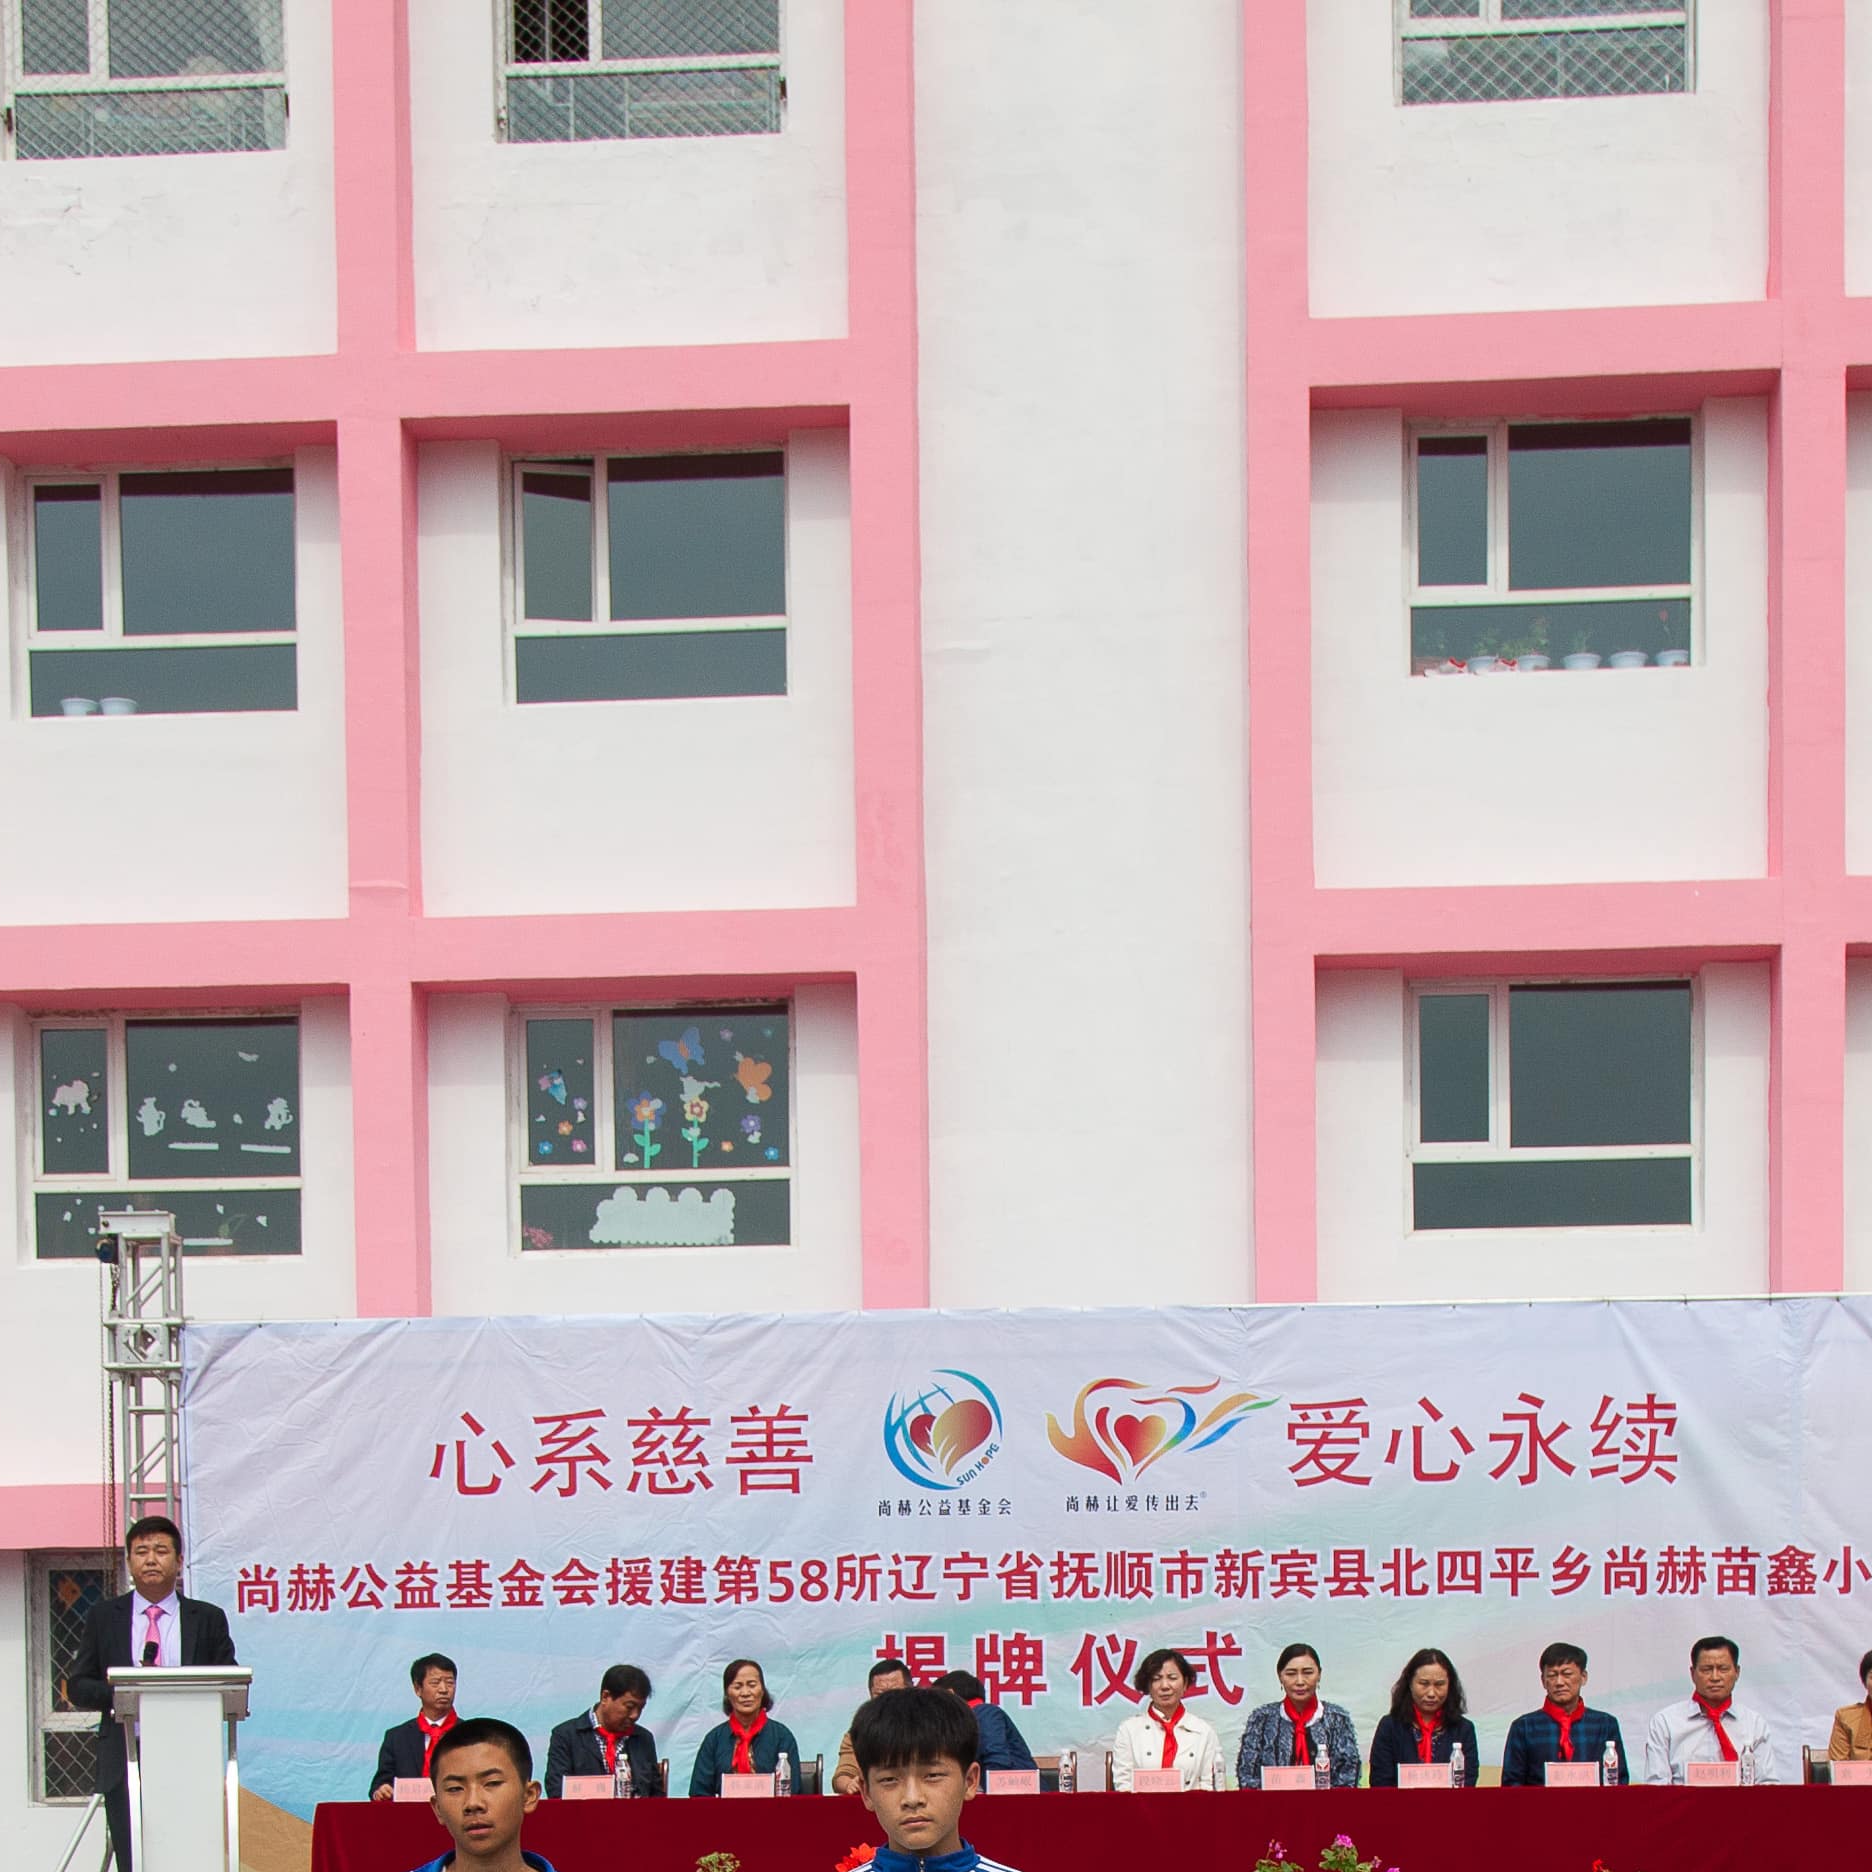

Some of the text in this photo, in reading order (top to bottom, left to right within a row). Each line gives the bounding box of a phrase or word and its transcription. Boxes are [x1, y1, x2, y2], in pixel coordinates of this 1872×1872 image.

[430, 1404, 814, 1497] 心系慈善
[1285, 1392, 1679, 1487] 爱心永续
[877, 1498, 1012, 1517] 尚赫公益基金会
